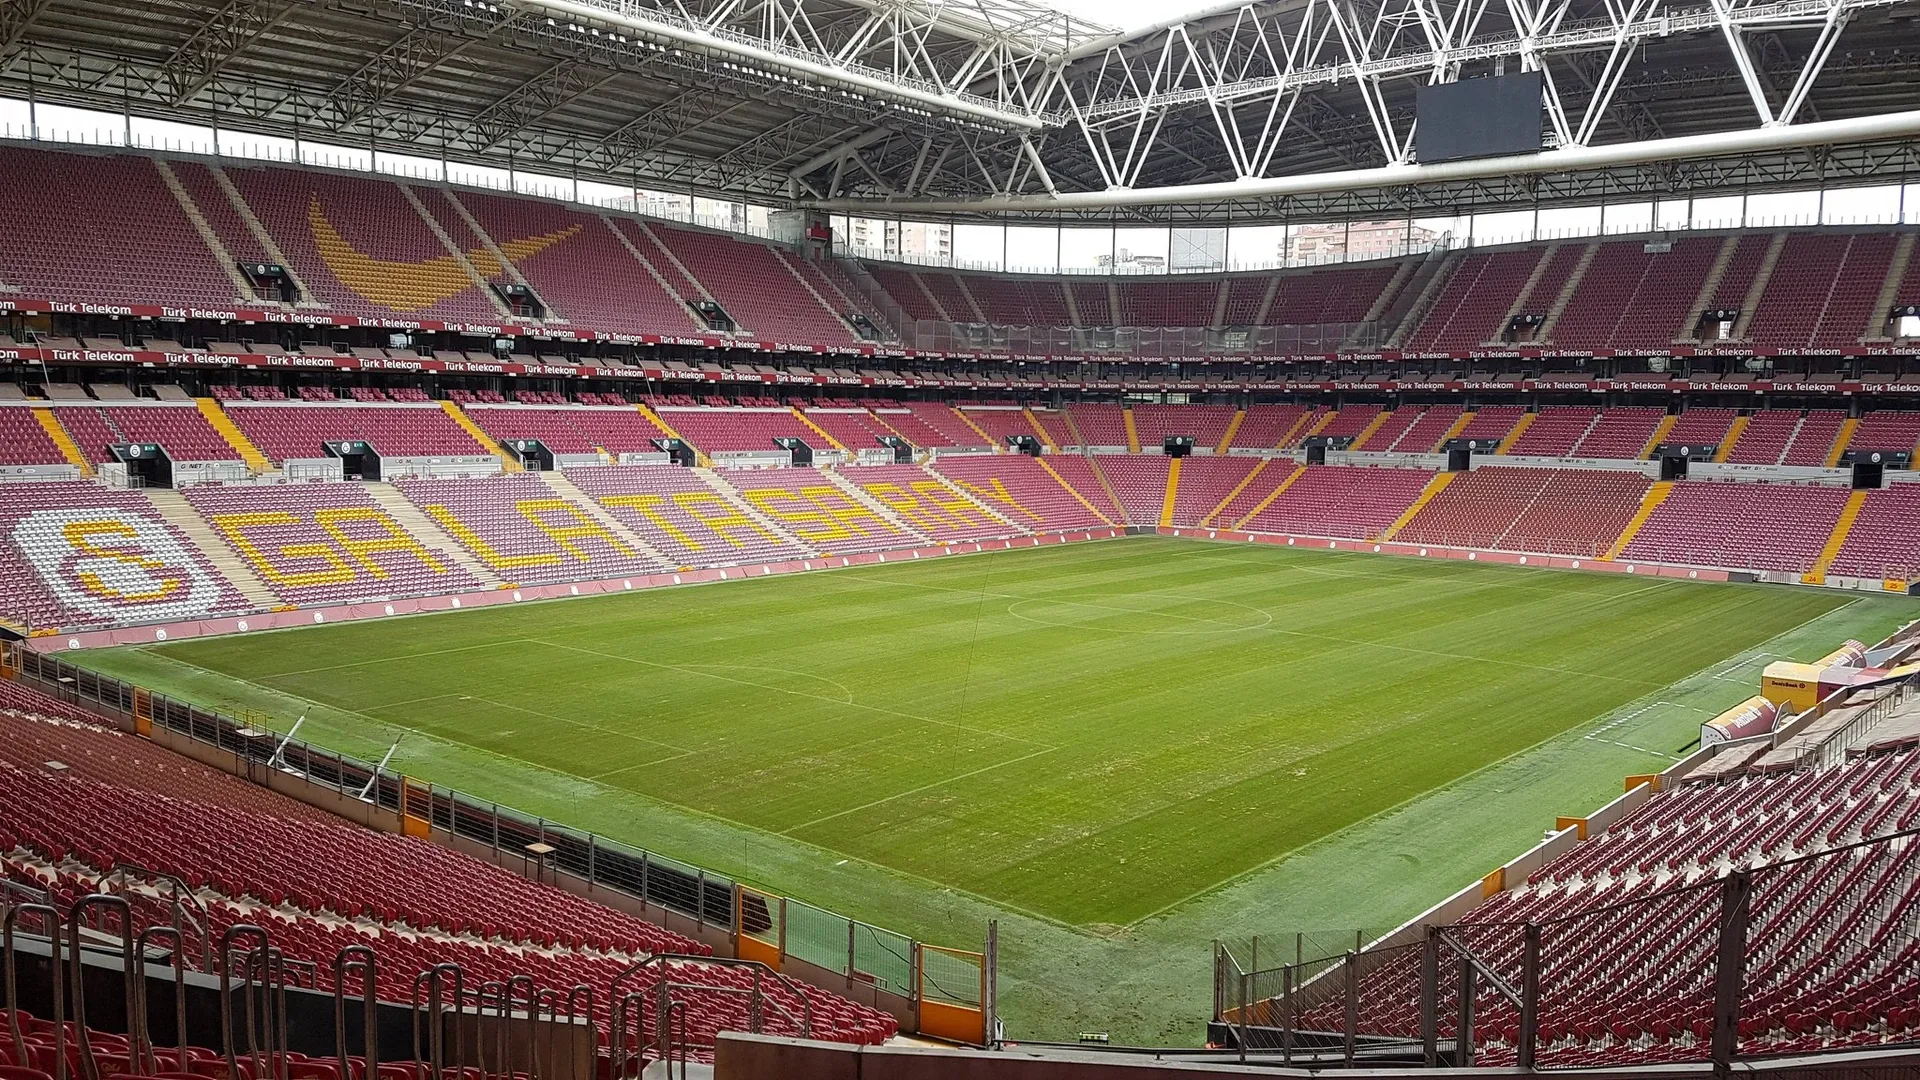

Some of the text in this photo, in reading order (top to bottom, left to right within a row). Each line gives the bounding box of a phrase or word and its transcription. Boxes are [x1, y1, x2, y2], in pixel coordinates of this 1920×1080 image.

[49, 301, 131, 314] Türk Telekom
[162, 306, 236, 319] Türk Telekom
[264, 311, 332, 324] Türk Telekom
[358, 317, 420, 329] Türk Telekom
[444, 321, 500, 334] Türk Telekom
[522, 327, 574, 338] Türk Telekom
[594, 331, 642, 342] Türk Telekom
[660, 336, 704, 346] Türk Telekom
[720, 339, 760, 349] Türk Telekom
[52, 350, 134, 362] Türk Telekom
[1487, 350, 1519, 358] Telekom
[1694, 348, 1753, 356] Türk Telekom
[1778, 348, 1797, 356] Türk
[1866, 347, 1888, 355] Türk
[164, 352, 238, 364] Türk Telekom
[266, 355, 333, 366] Türk Telekom
[359, 359, 421, 369] Türk Telekom
[445, 362, 502, 372] Türk Telekom
[524, 365, 576, 374] Türk Telekom
[596, 367, 643, 377] Türk Telekom
[661, 370, 705, 379] Türk Telekom
[736, 373, 761, 381] Telekom
[1795, 383, 1835, 391] Telekom
[212, 477, 1044, 588] GALATASARAY
